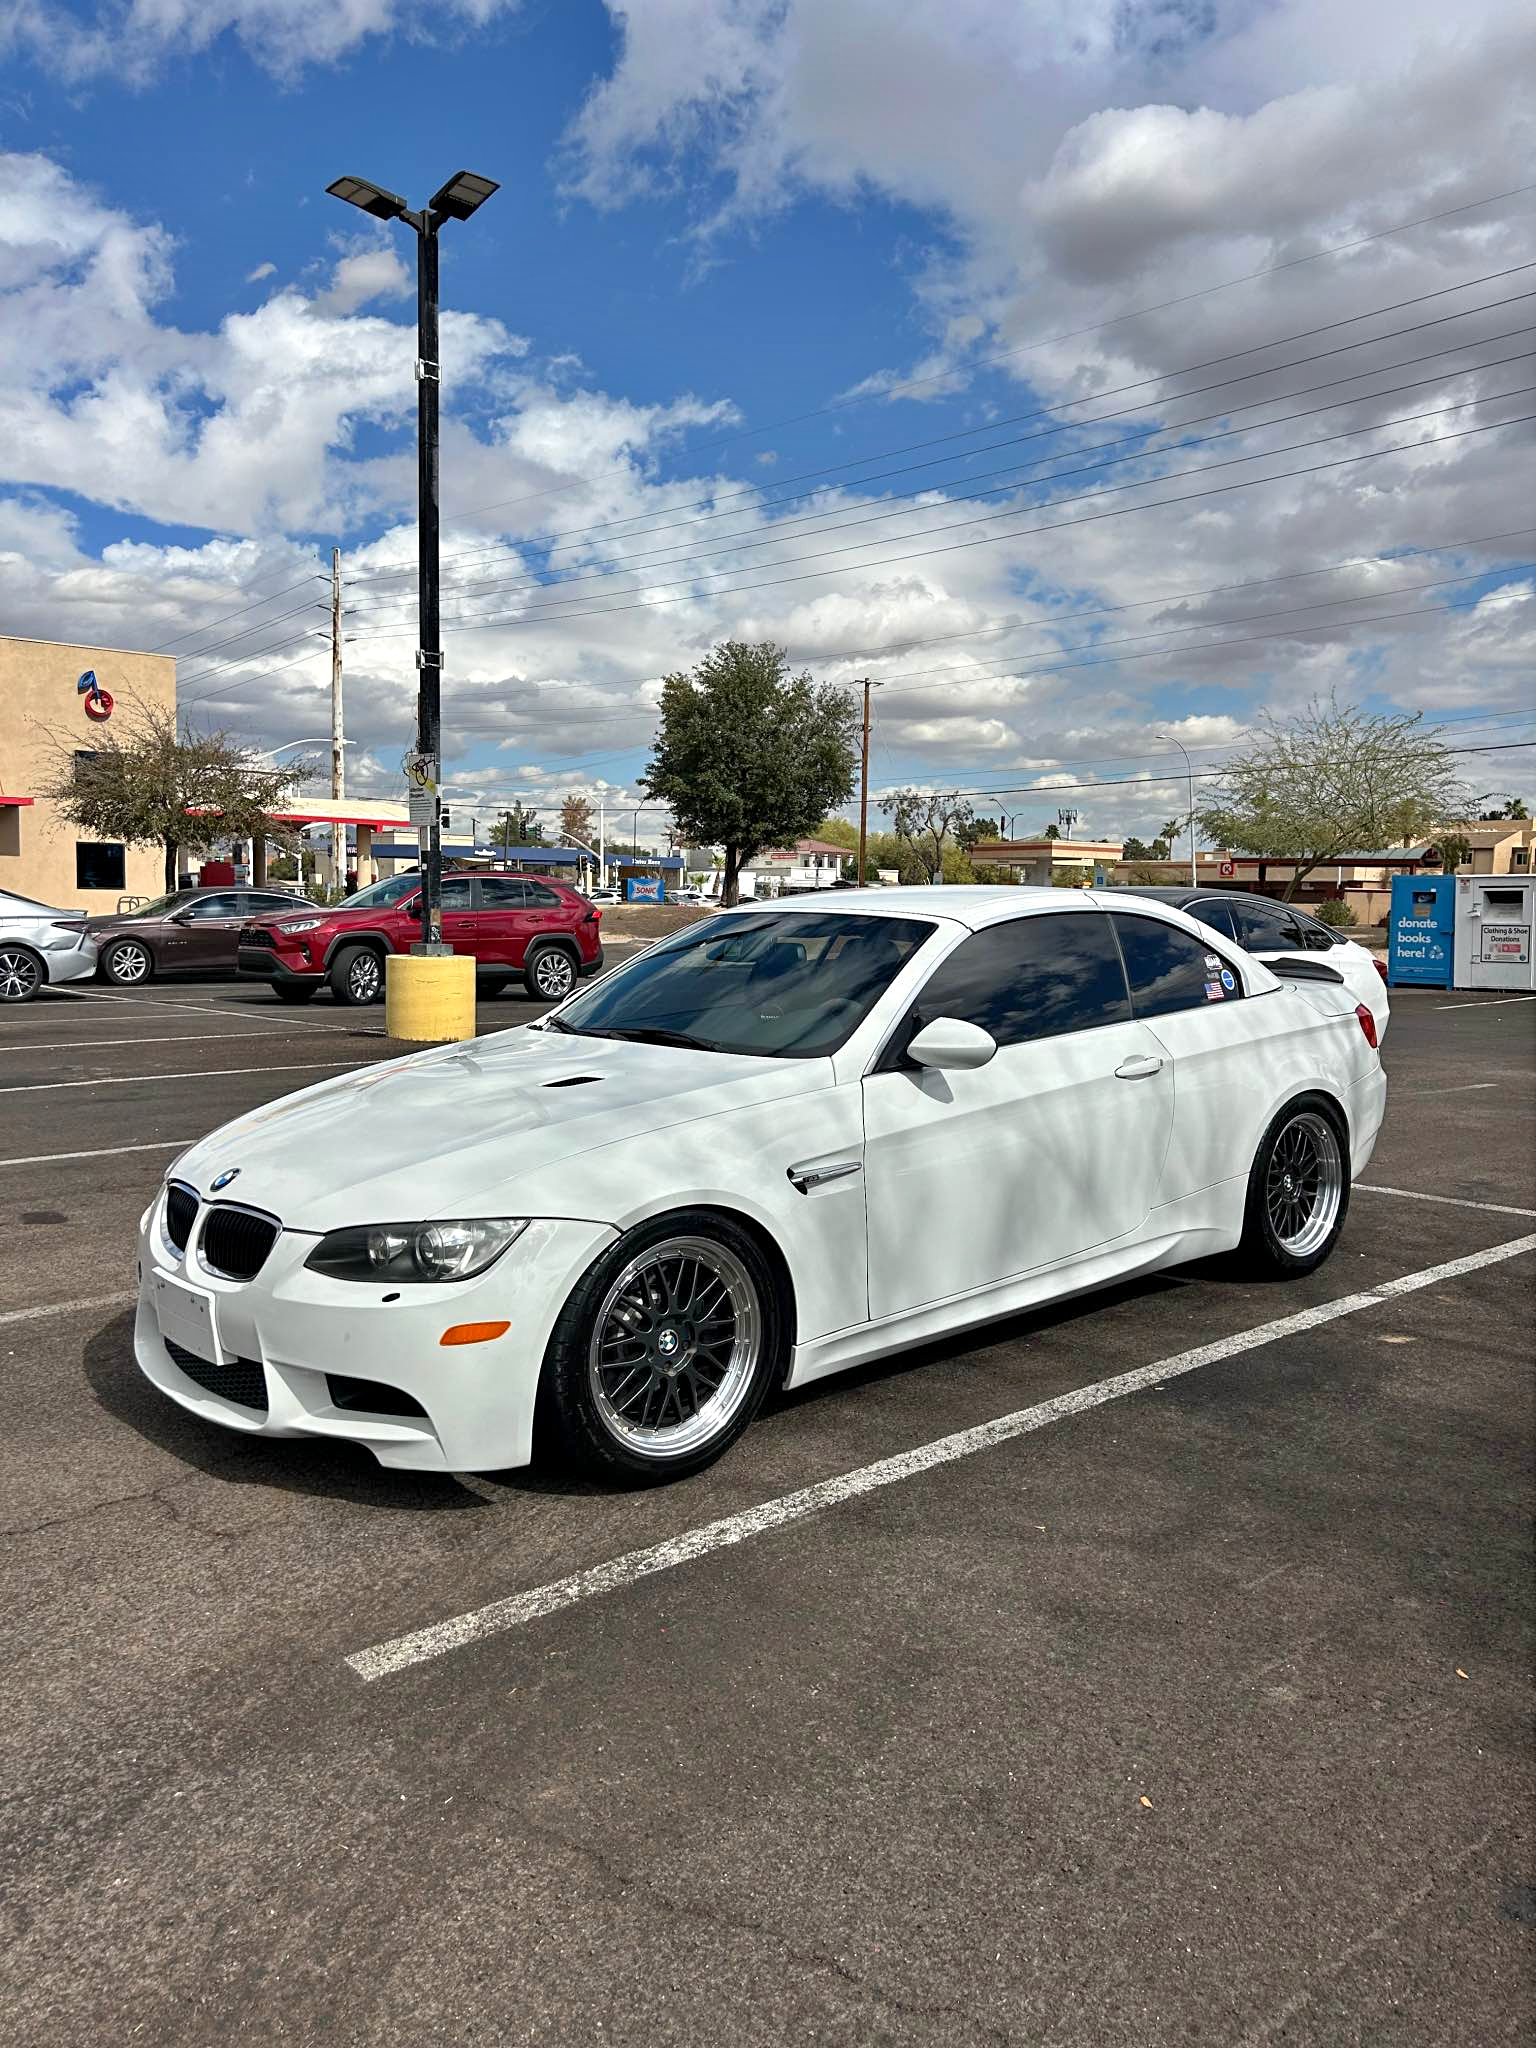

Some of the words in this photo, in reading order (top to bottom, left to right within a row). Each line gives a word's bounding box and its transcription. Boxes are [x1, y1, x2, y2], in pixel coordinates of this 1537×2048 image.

[636, 886, 657, 894] SONIC
[1398, 916, 1438, 928] donate
[1397, 931, 1432, 943] books
[1483, 927, 1507, 935] Clothing
[1397, 946, 1426, 958] here!
